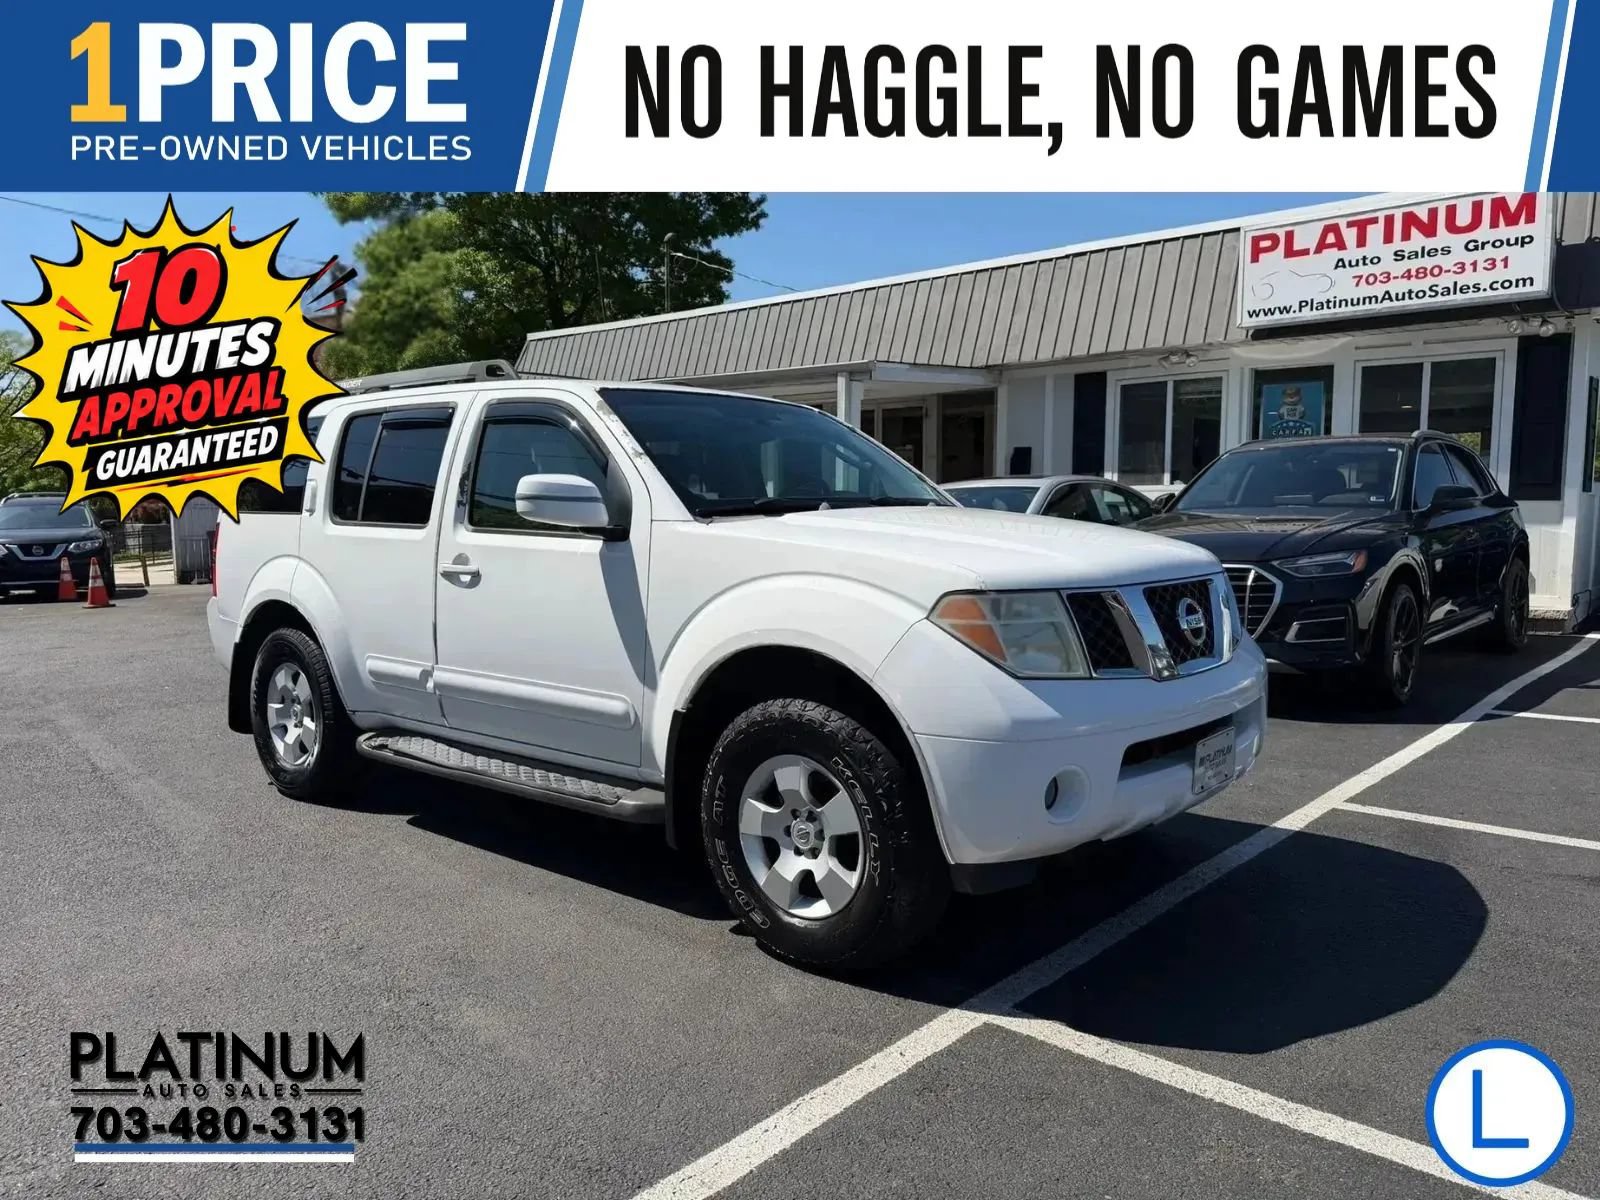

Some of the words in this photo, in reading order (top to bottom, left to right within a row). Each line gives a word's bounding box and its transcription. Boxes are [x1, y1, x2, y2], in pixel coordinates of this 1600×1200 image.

[1250, 192, 1537, 264] PLATINUM
[1333, 253, 1382, 270] Auto
[1392, 243, 1452, 262] Sales
[1463, 233, 1535, 253] Group
[1351, 255, 1510, 288] 703-480-3131
[1247, 275, 1535, 319] www.PlatinumAutoSales.com
[830, 757, 881, 887] KELLY
